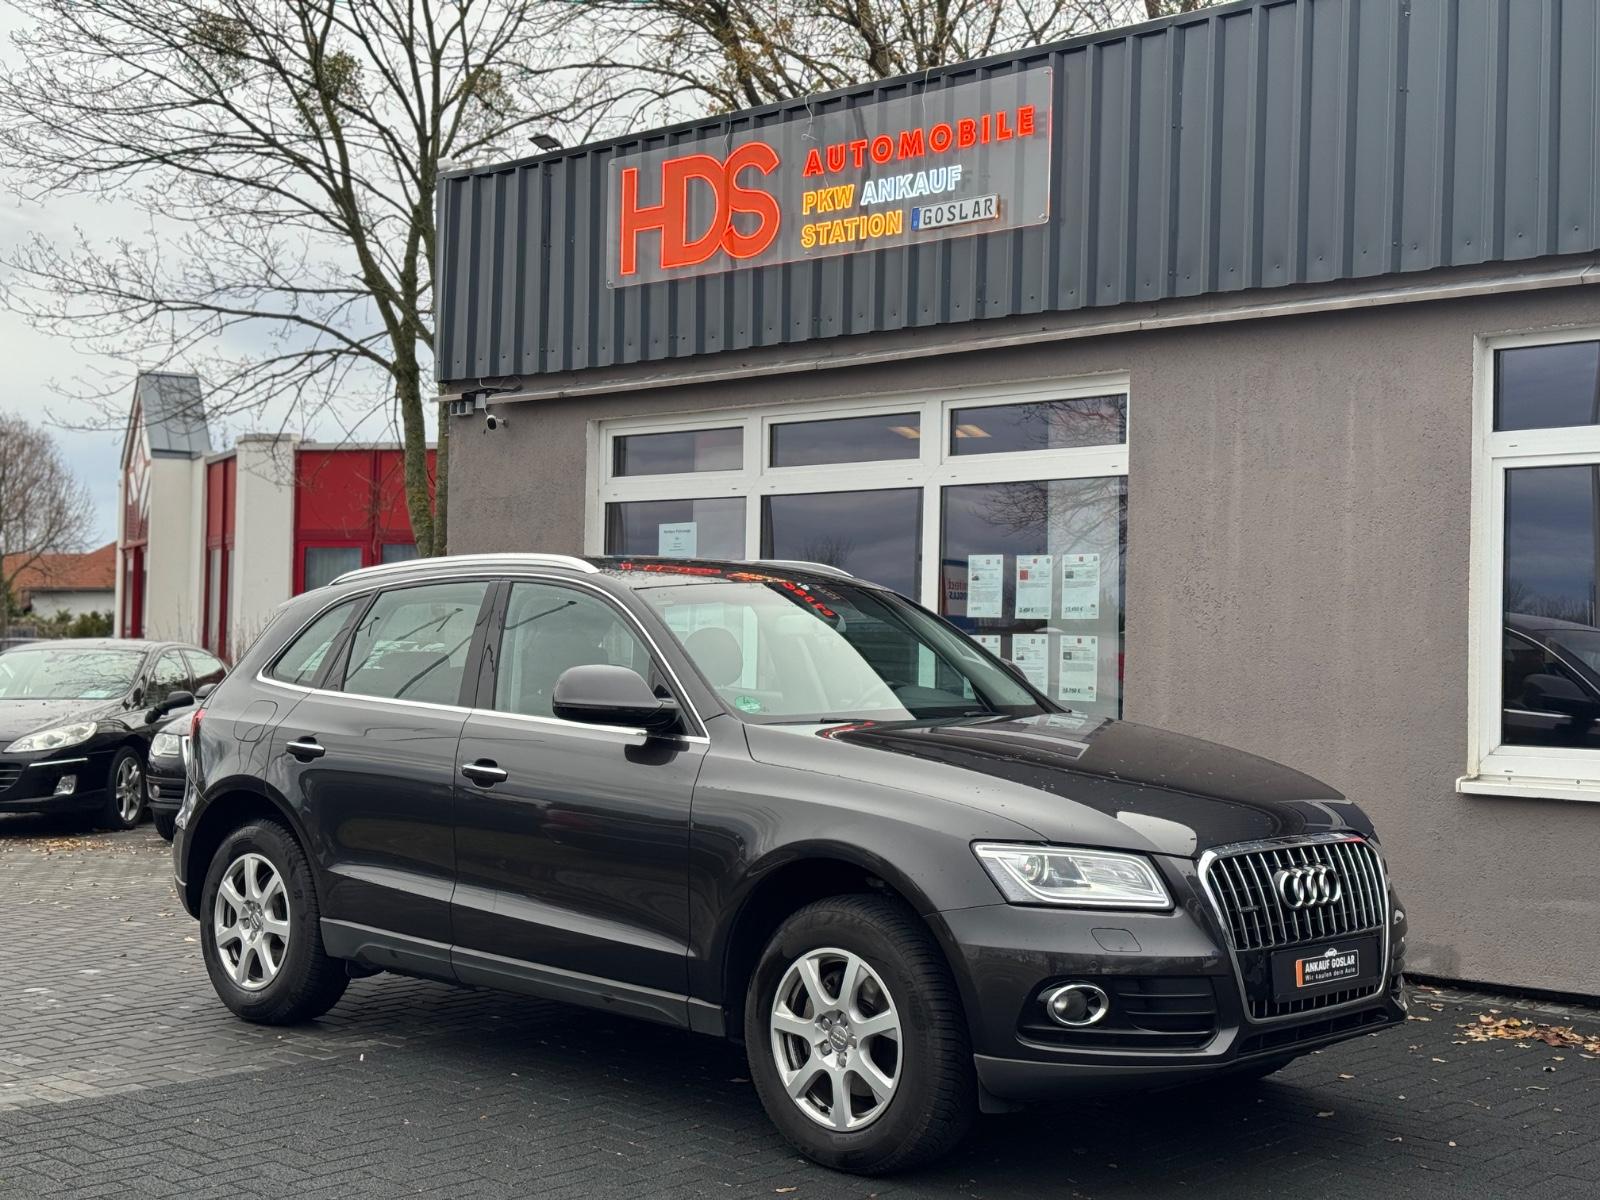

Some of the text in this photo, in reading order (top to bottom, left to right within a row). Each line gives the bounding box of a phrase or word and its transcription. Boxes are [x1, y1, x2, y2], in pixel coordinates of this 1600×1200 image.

[802, 104, 1035, 177] AUTOMOBILE
[620, 141, 781, 276] HDS
[802, 164, 963, 215] PKW ANKAUF
[922, 197, 993, 226] GOSLAR
[800, 209, 903, 248] STATION
[1305, 954, 1354, 973] ANKAUF GOSLAR
